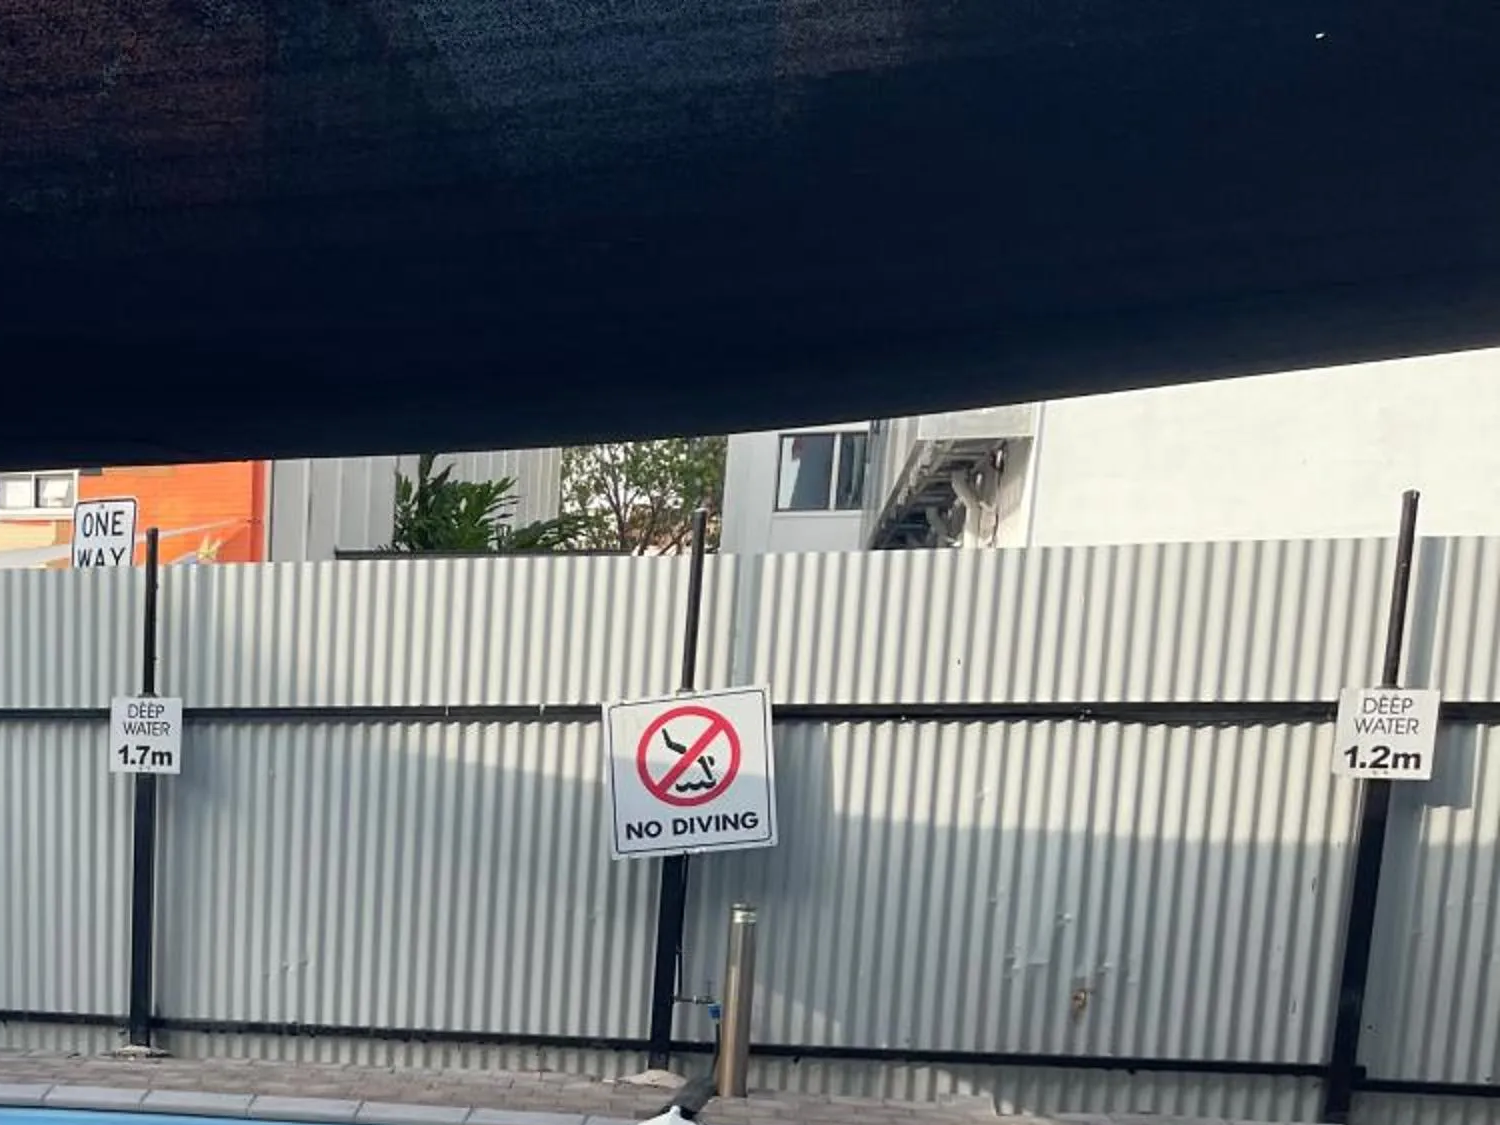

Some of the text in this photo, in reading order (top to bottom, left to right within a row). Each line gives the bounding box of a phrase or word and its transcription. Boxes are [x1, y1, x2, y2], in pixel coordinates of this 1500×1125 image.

[82, 511, 125, 537] ONE
[77, 547, 126, 567] WAY
[127, 703, 165, 719] DEEP
[1362, 697, 1413, 714] DEEP
[123, 722, 171, 736] WATER
[1354, 717, 1419, 735] WATER
[118, 745, 172, 766] 1.7m
[1344, 745, 1421, 769] 1.2m
[626, 811, 759, 840] NO DIVING
